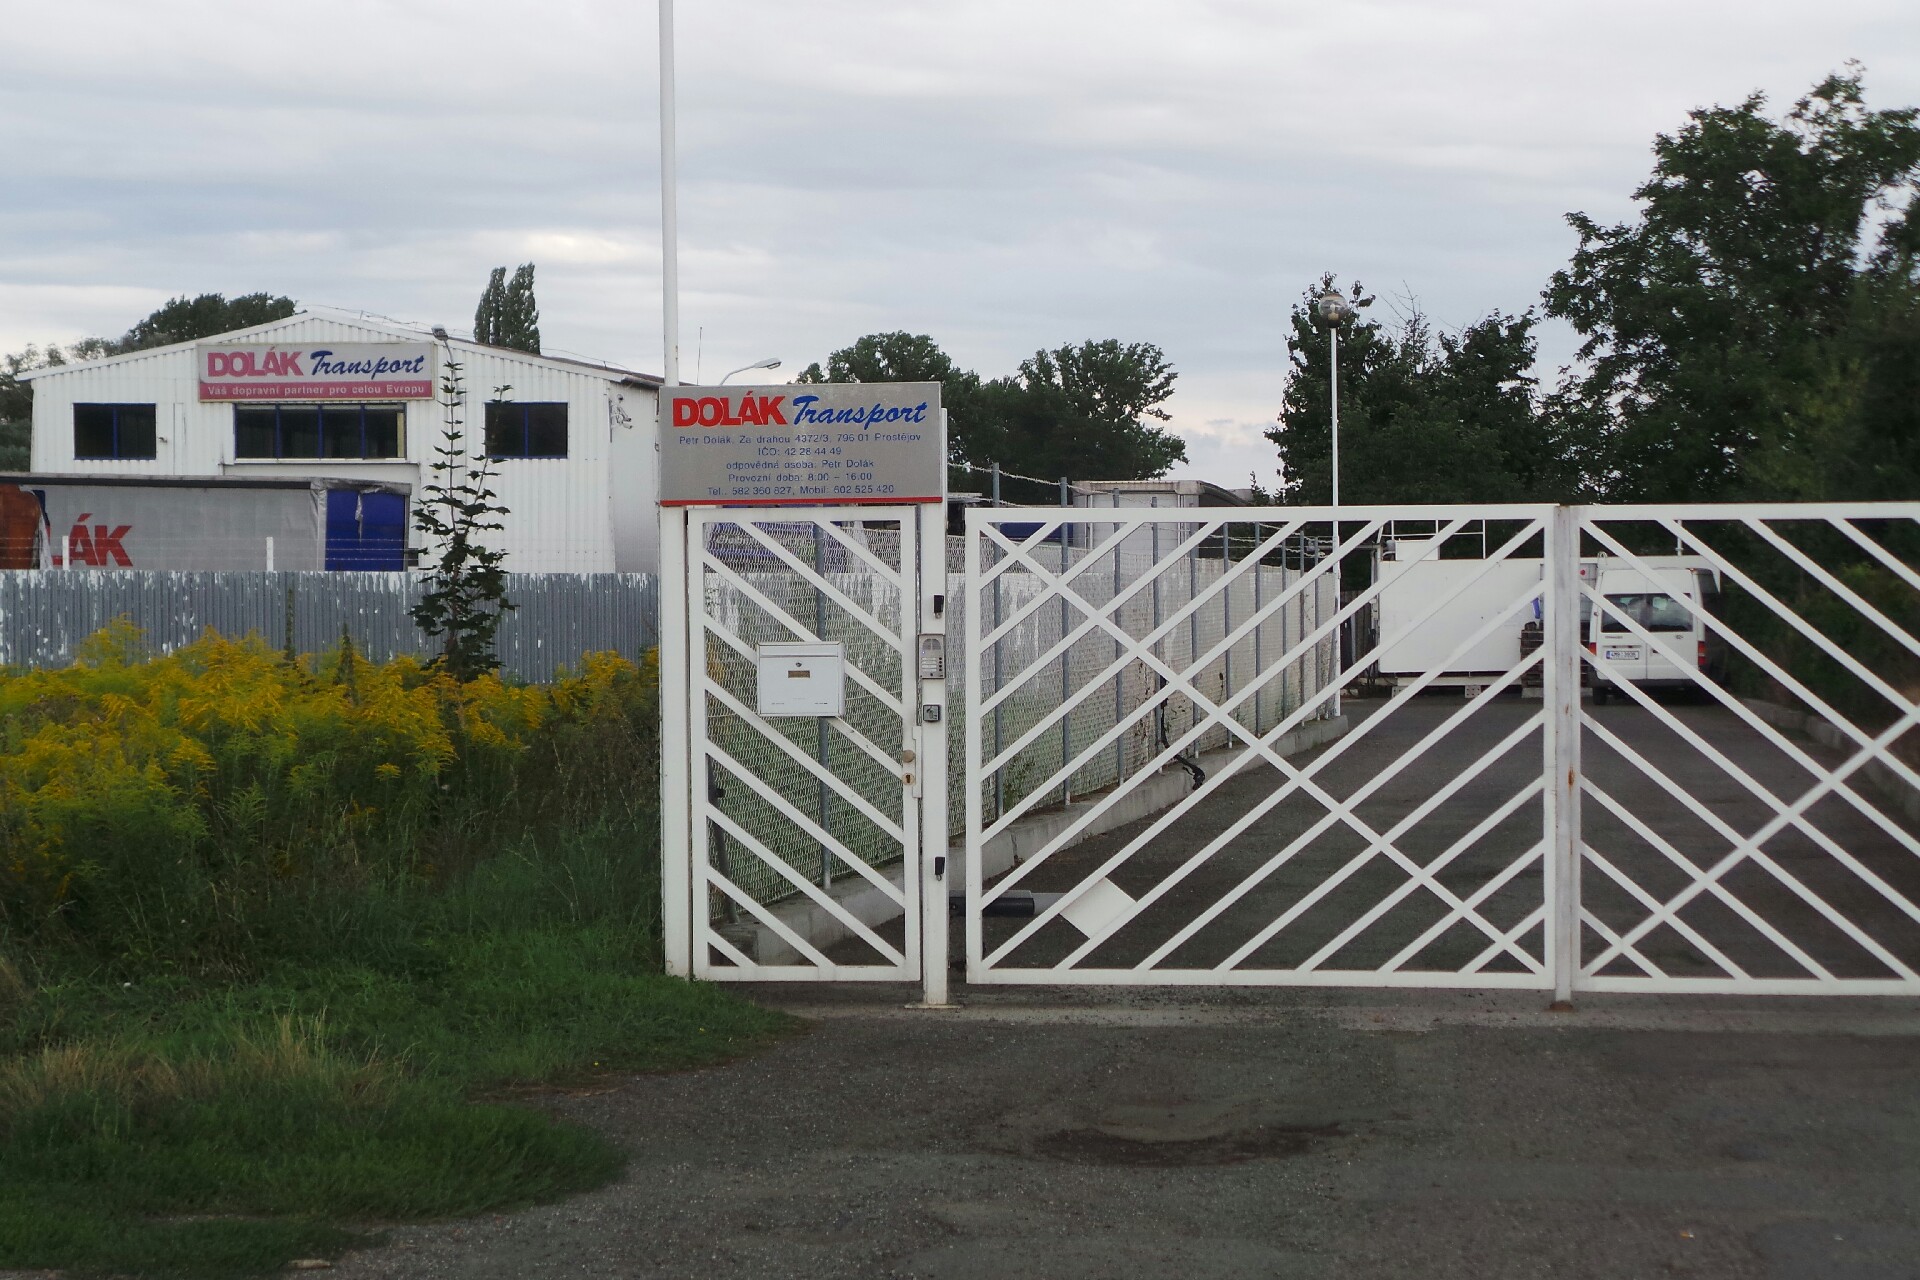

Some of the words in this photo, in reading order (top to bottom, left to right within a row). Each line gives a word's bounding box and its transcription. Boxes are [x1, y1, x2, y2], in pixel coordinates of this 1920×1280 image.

[208, 347, 303, 377] DOLÁK
[310, 350, 424, 380] Transport
[208, 386, 227, 395] Váš
[233, 386, 279, 396] dopravní
[285, 386, 324, 396] partner
[329, 387, 347, 396] pro
[352, 385, 381, 394] celou
[386, 385, 424, 395] Evropu
[672, 391, 788, 427] DOLÁK
[792, 395, 928, 430] Transport
[679, 436, 699, 445] Petr
[740, 435, 751, 443] Za
[757, 435, 790, 443] drahou
[837, 434, 855, 442] 796
[858, 433, 869, 441] 01
[814, 447, 826, 455] 44
[829, 447, 842, 455] 49
[822, 459, 841, 468] Petr
[846, 459, 874, 467] Dolák
[728, 473, 771, 482] Provozní
[776, 473, 803, 482] doba:
[732, 486, 750, 494] 582
[752, 486, 771, 494] 360
[833, 485, 852, 493] 602
[854, 485, 873, 493] 525
[875, 484, 894, 493] 420
